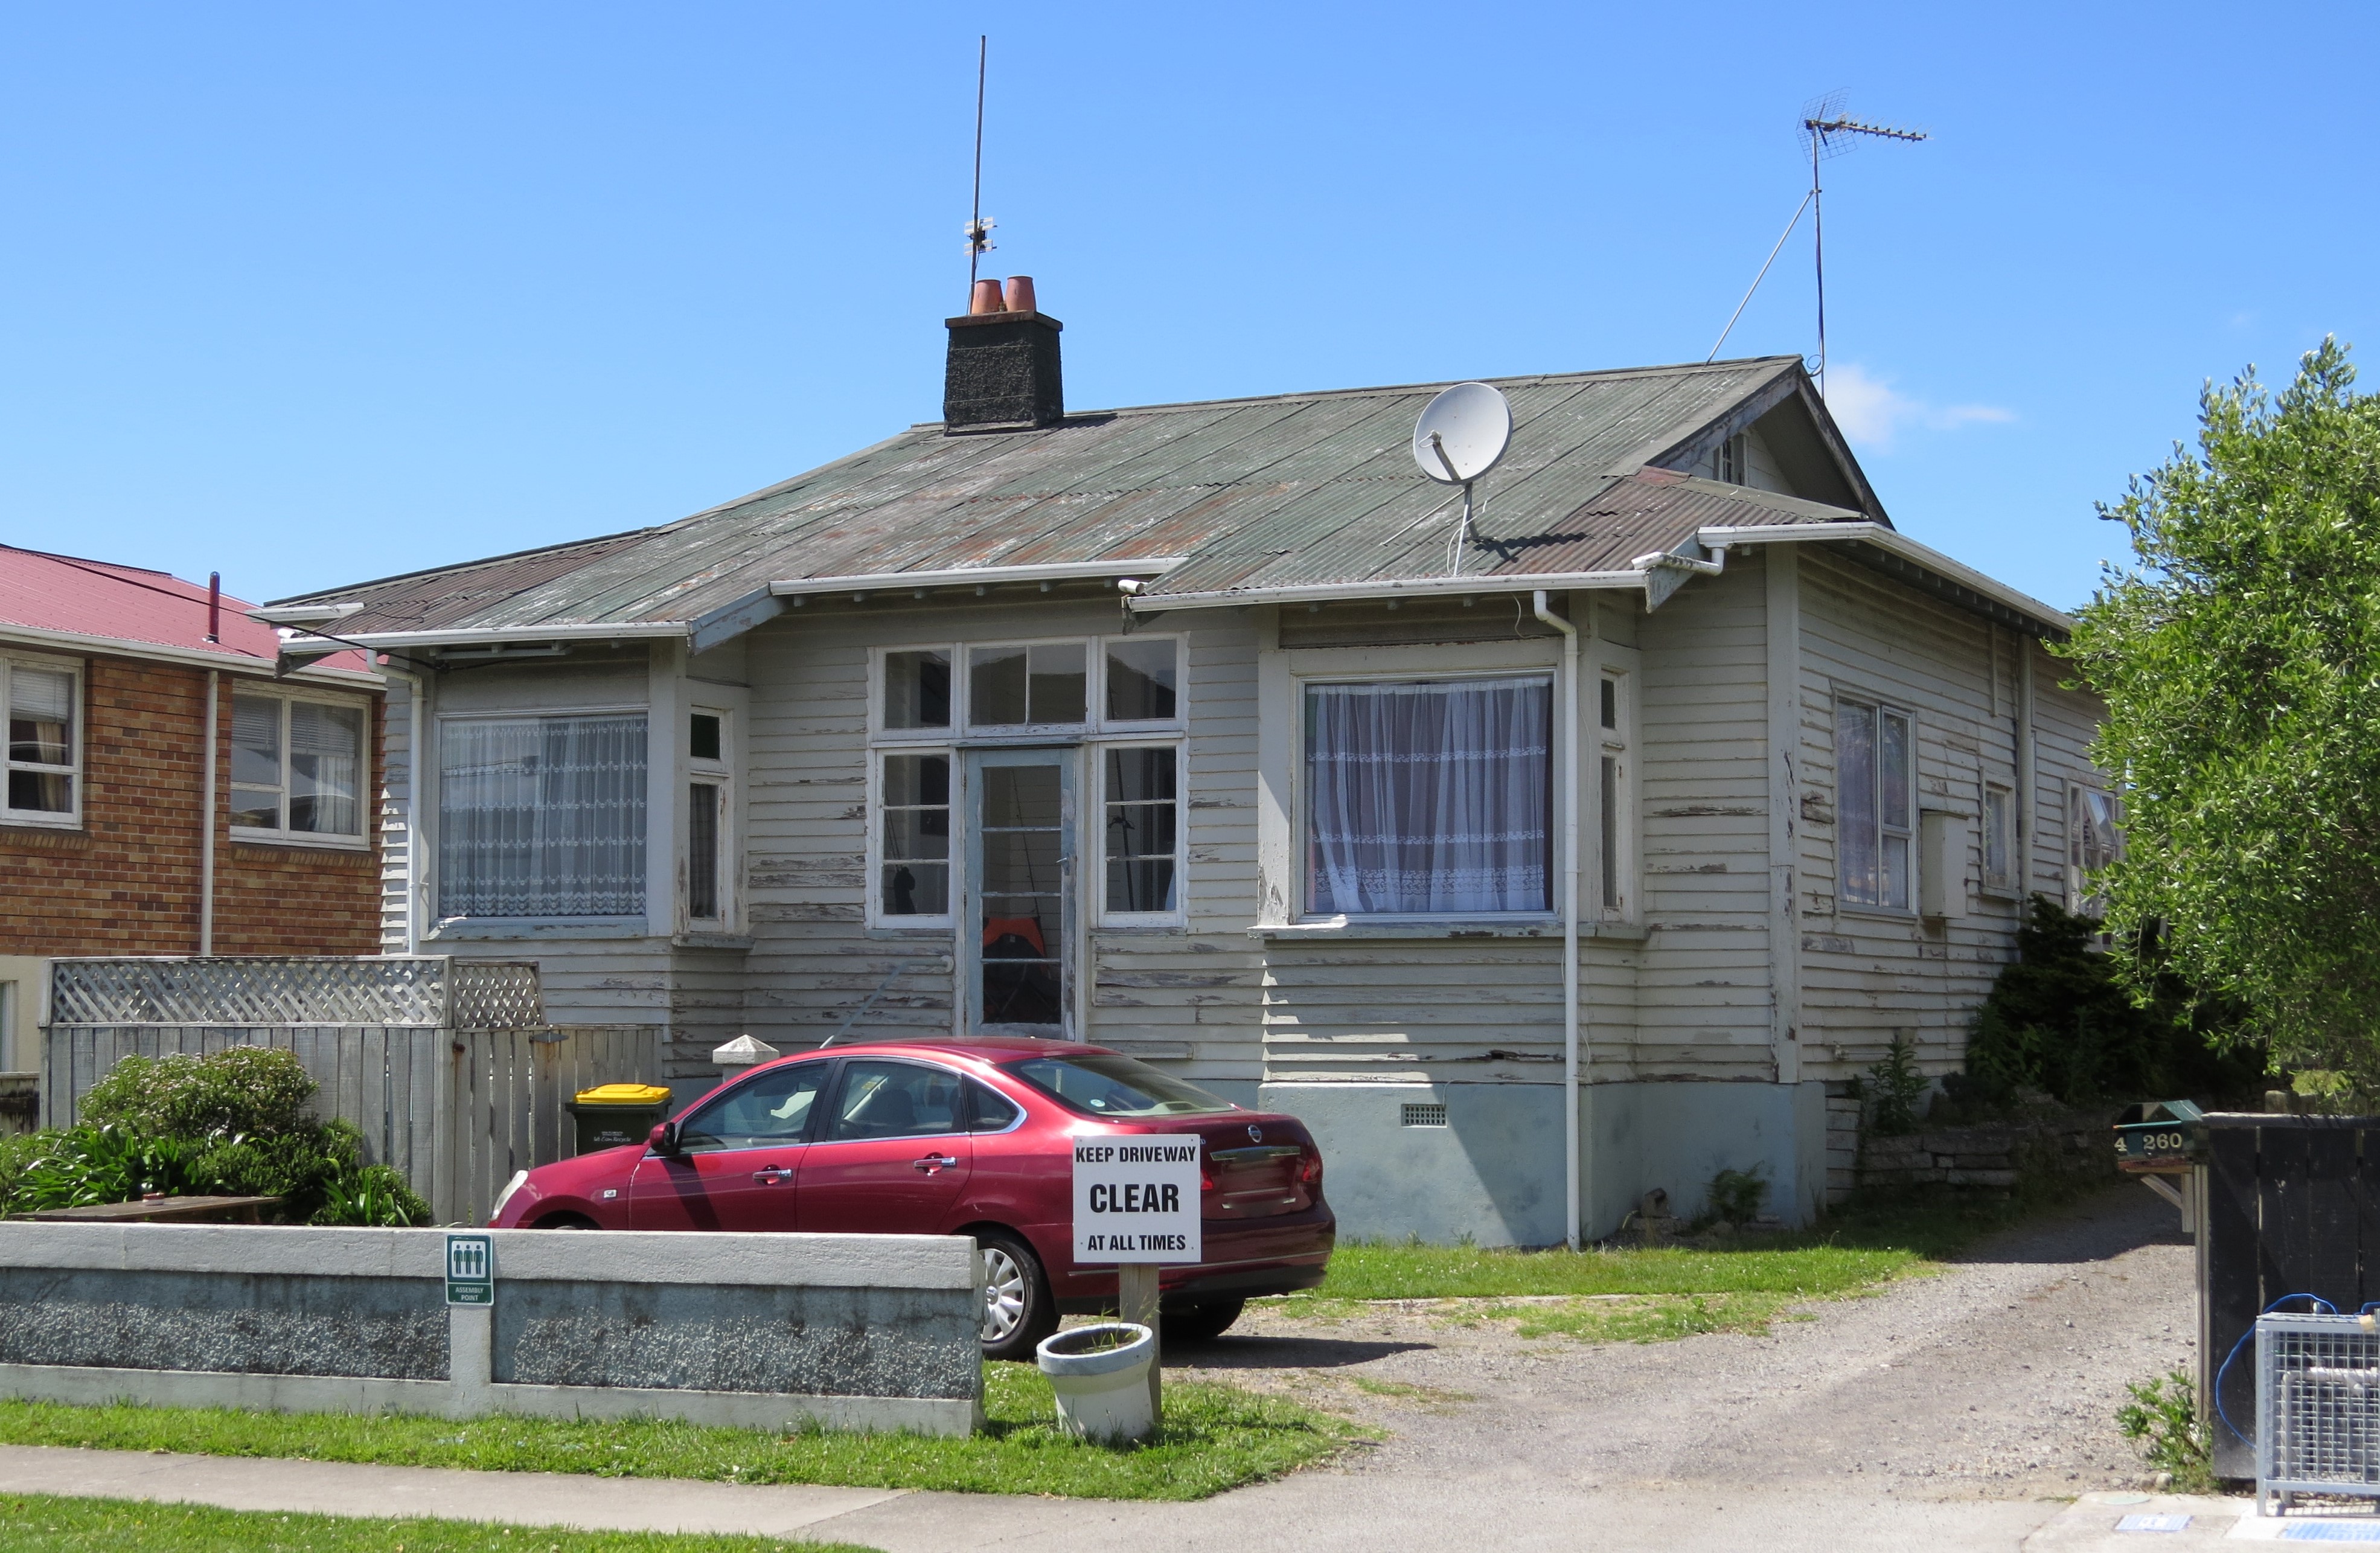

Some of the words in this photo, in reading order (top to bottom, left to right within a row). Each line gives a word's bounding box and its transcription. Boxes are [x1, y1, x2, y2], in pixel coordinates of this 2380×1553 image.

[2143, 1133, 2182, 1150] 260
[1076, 1147, 1114, 1162] KEEP
[1119, 1147, 1196, 1162] DRIVEWAY
[1090, 1184, 1179, 1212] CLEAR
[1087, 1235, 1105, 1250] AT
[1109, 1235, 1136, 1250] ALL
[1139, 1235, 1186, 1250] TIMES
